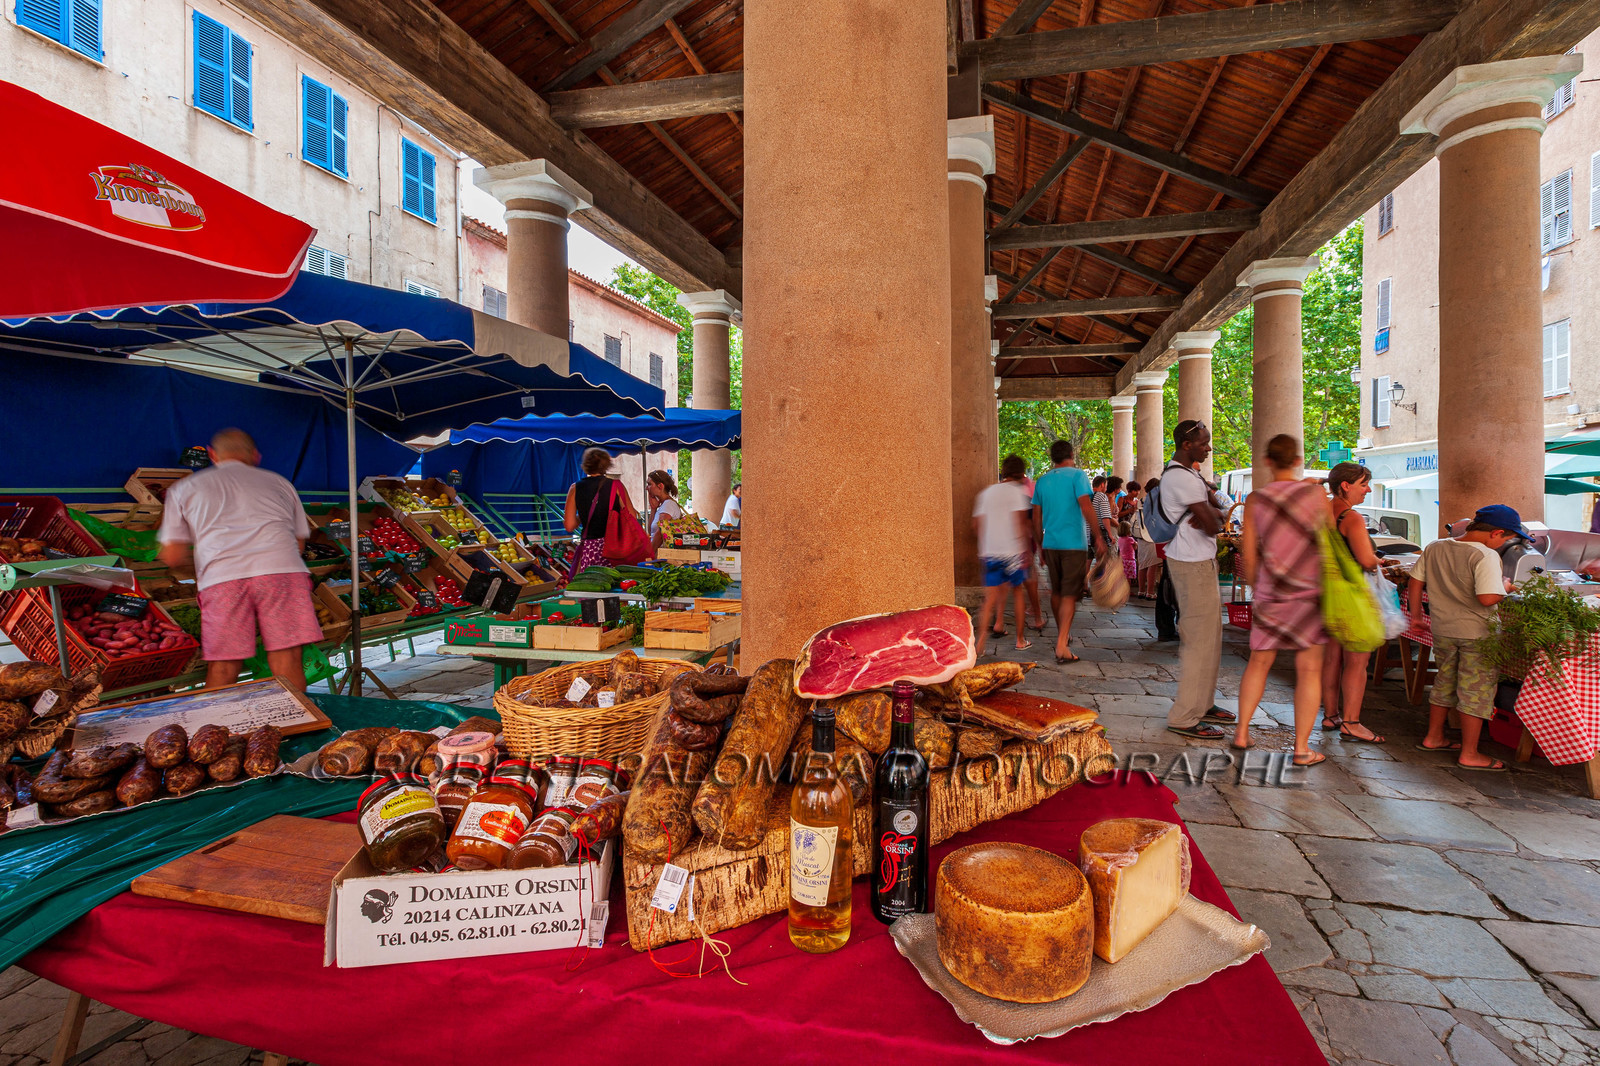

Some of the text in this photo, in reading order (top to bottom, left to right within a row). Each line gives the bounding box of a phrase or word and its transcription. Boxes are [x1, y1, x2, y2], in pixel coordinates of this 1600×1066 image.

[89, 172, 206, 222] Kronenbourg
[885, 845, 915, 855] ORSINI
[408, 878, 588, 904] DOMAINE ORSINI
[404, 901, 565, 925] 20214 CALINZANA
[377, 932, 406, 947] Tél.
[410, 929, 454, 944] 04.95.
[457, 924, 517, 941] 62.81.01
[531, 918, 588, 936] 62.80.21
